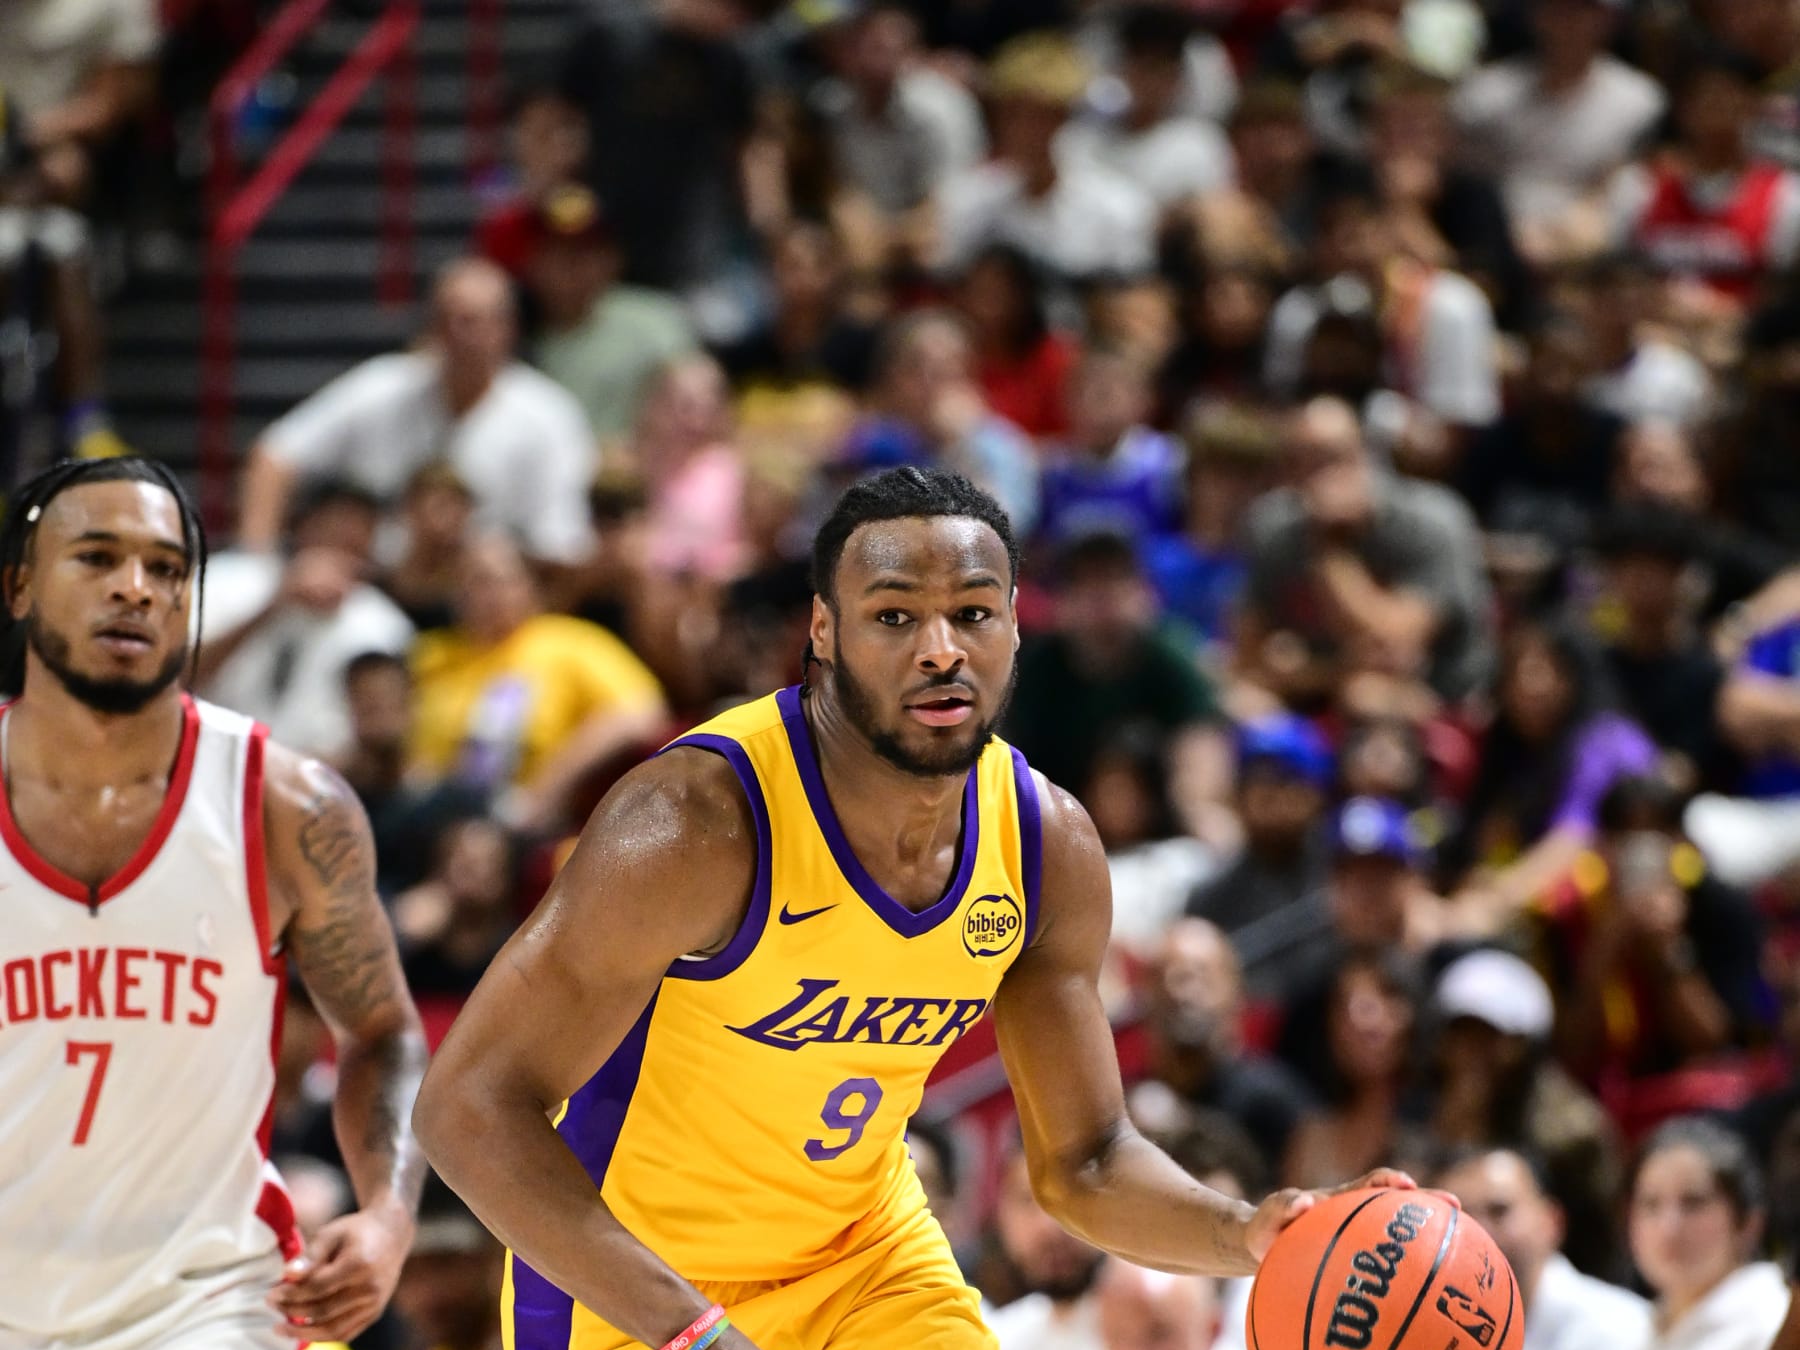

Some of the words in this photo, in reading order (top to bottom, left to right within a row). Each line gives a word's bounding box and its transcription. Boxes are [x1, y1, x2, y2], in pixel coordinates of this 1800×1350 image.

[967, 911, 1017, 937] bibigo
[0, 948, 223, 1029] OCKETS
[65, 1040, 113, 1147] 7
[803, 1077, 884, 1162] 9
[1325, 1203, 1434, 1350] Wilson
